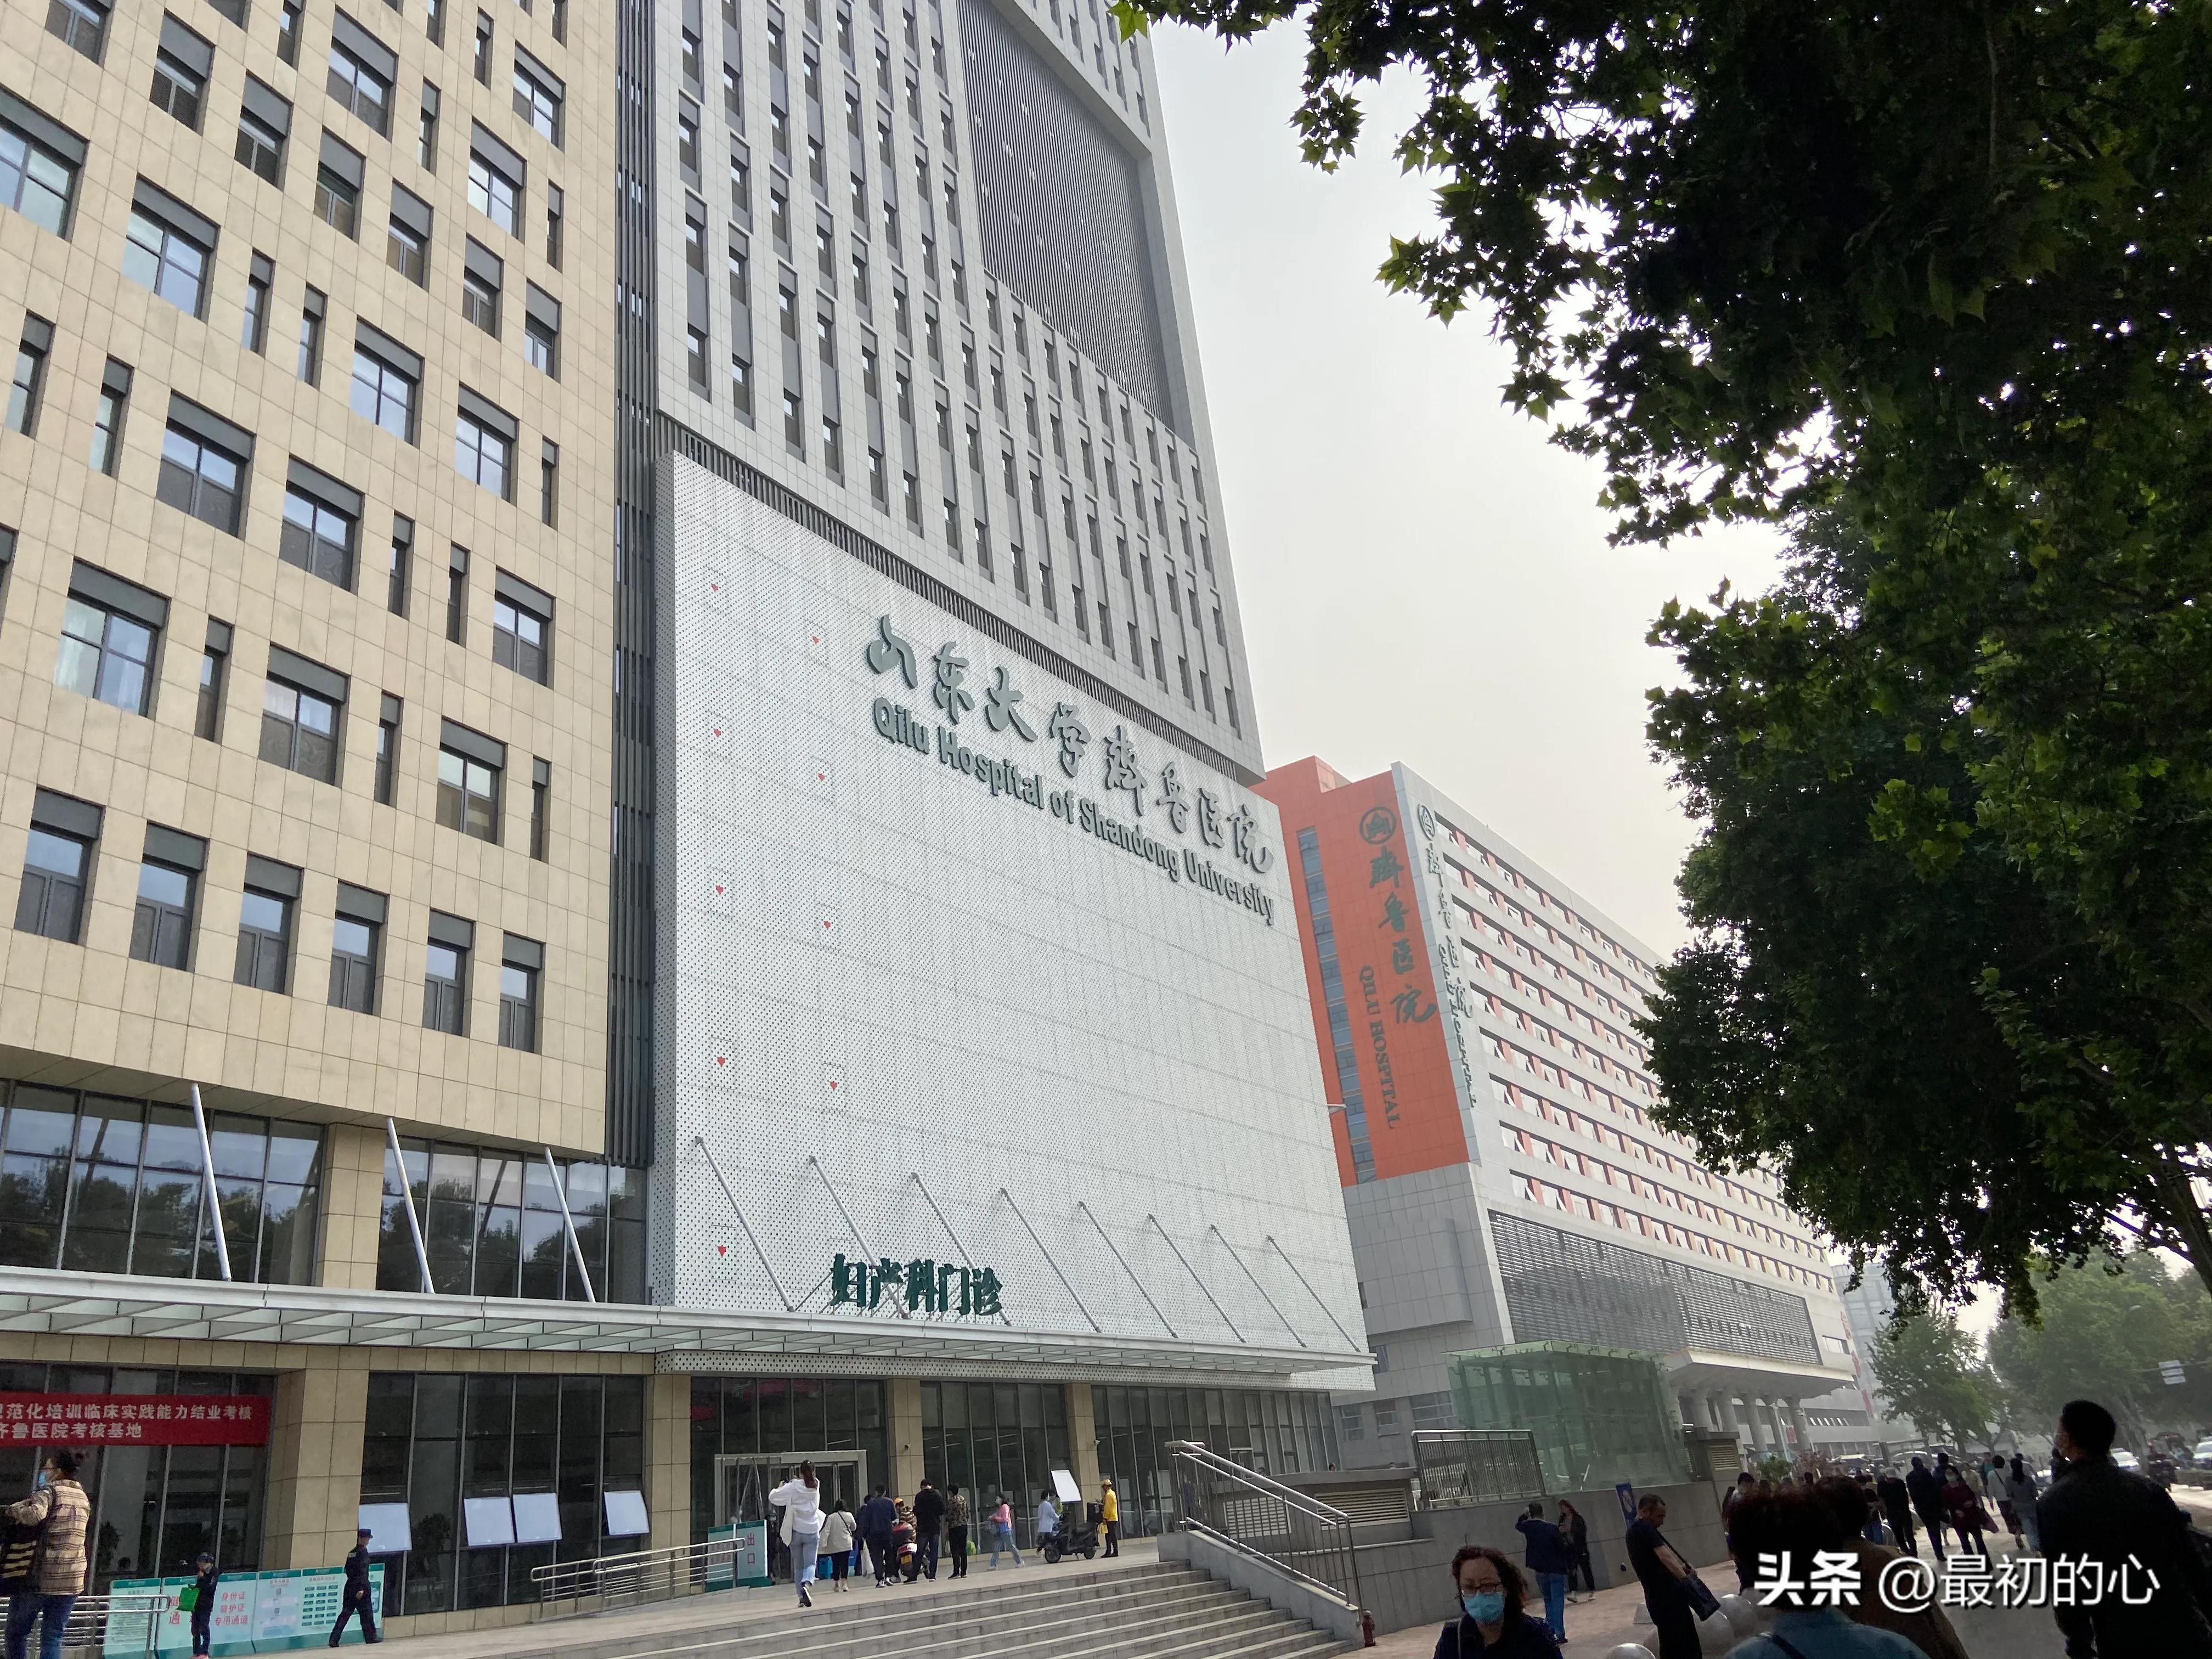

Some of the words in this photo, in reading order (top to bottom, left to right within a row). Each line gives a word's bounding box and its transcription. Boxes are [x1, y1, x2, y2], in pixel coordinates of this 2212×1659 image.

[873, 696, 930, 755] Qilu
[937, 724, 1045, 810] Hospital
[1049, 789, 1074, 824] of
[1079, 797, 1181, 882] Shandong
[1183, 848, 1274, 926] University
[1359, 964, 1381, 1015] QILU
[1369, 1019, 1403, 1130] HOSPITAL
[830, 1253, 1004, 1316] 妇产科门诊
[0, 1402, 252, 1420] 范化培训临床实践能力结业考核
[747, 1532, 755, 1565] 出口
